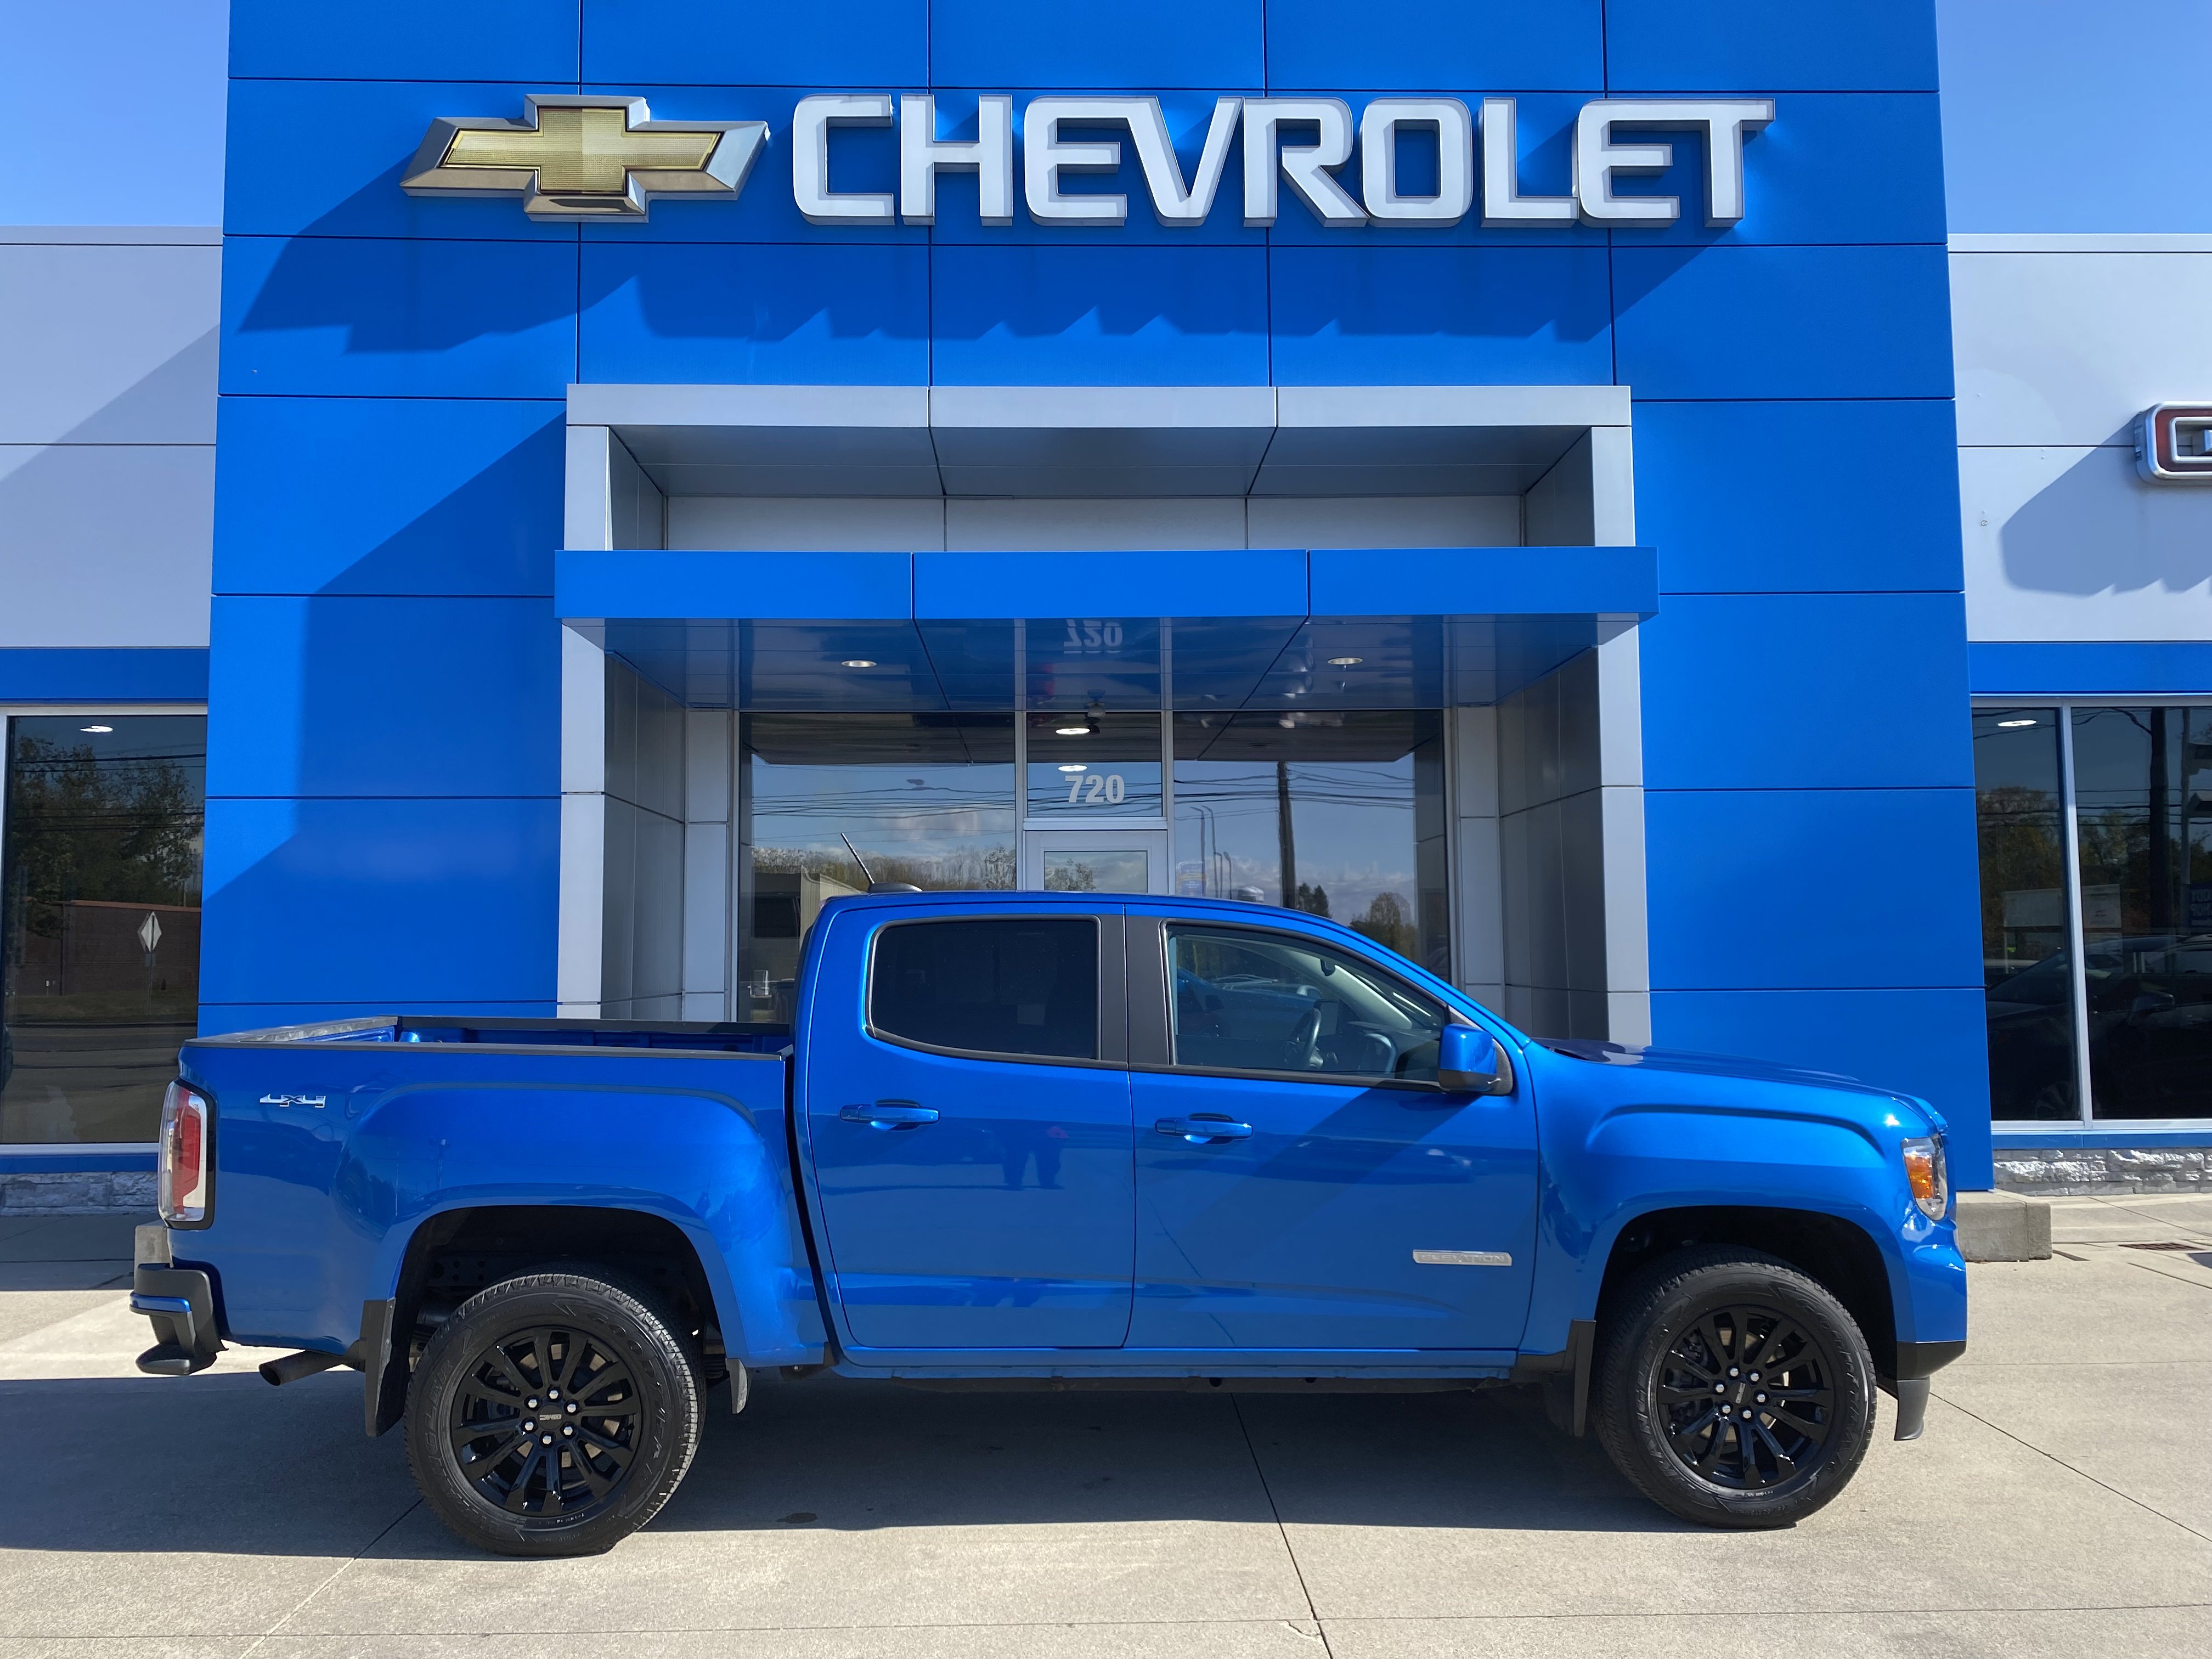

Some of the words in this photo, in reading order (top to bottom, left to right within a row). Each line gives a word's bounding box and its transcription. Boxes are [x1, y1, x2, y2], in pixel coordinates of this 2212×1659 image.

[792, 94, 1776, 229] CHEVROLET
[1065, 775, 1125, 804] 720
[1421, 1252, 1504, 1262] ELEVATION
